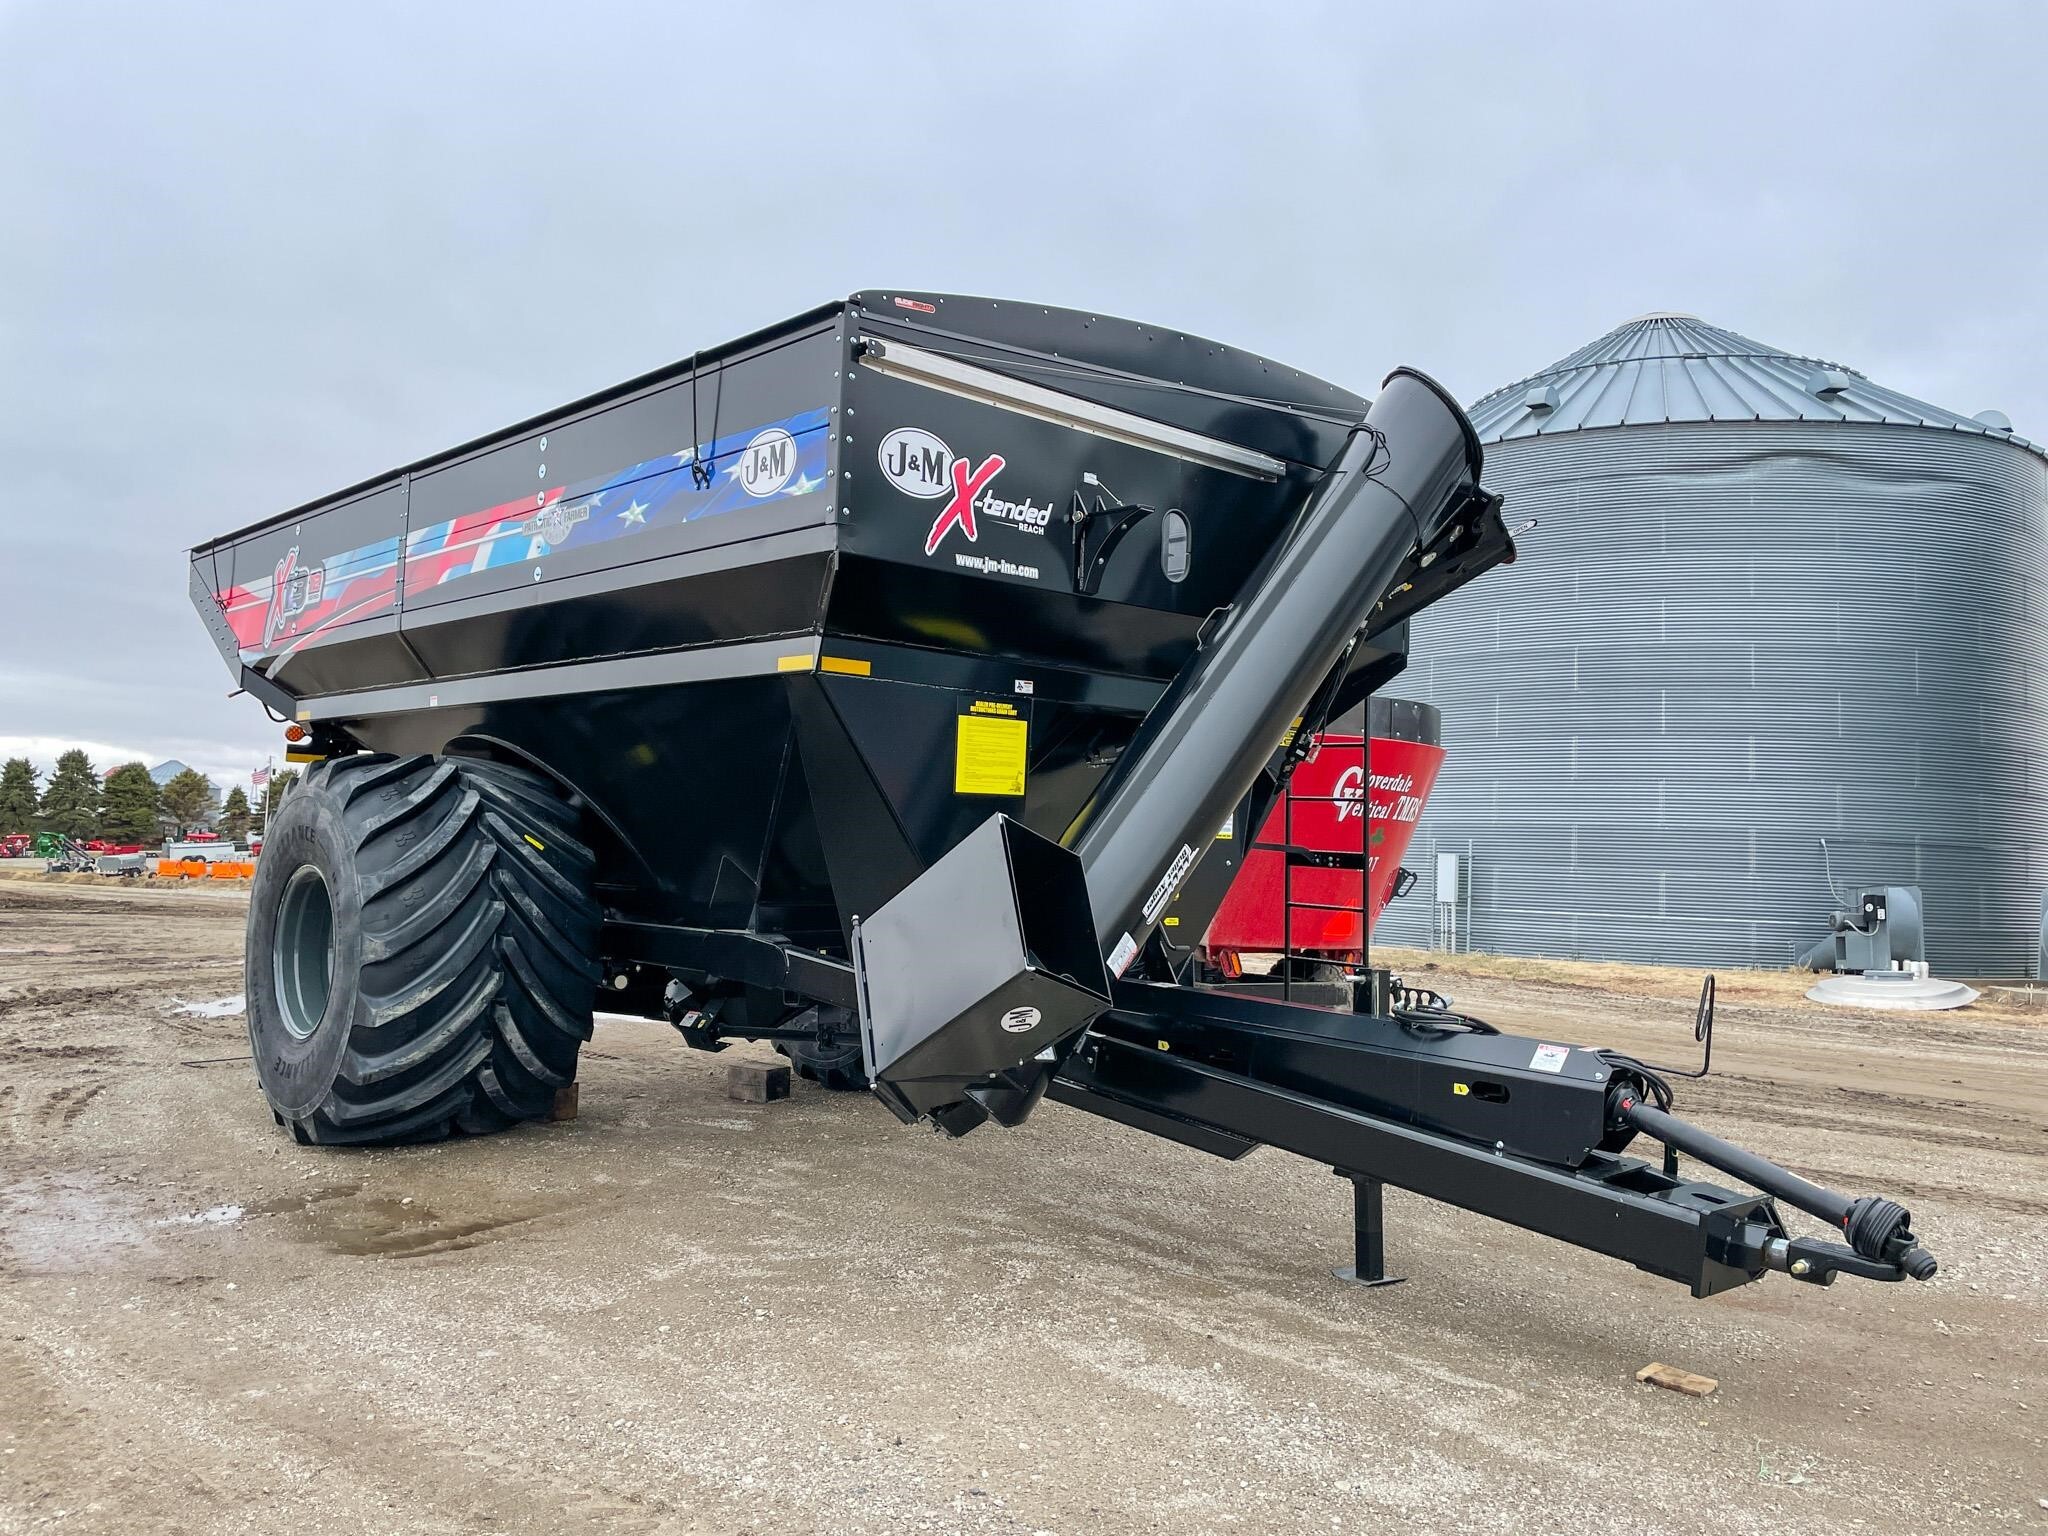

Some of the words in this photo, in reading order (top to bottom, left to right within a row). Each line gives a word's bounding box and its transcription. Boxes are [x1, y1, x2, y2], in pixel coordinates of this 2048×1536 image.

[746, 440, 789, 485] J&M
[887, 441, 946, 487] J&M
[1018, 523, 1045, 536] REACH
[1513, 525, 1529, 535] OPEN
[955, 552, 1040, 580] www.jm-inc.com
[1333, 766, 1413, 806] Coverdale
[1167, 849, 1188, 880] Bullet
[1146, 881, 1167, 912] Auger
[1008, 1009, 1034, 1031] J&M
